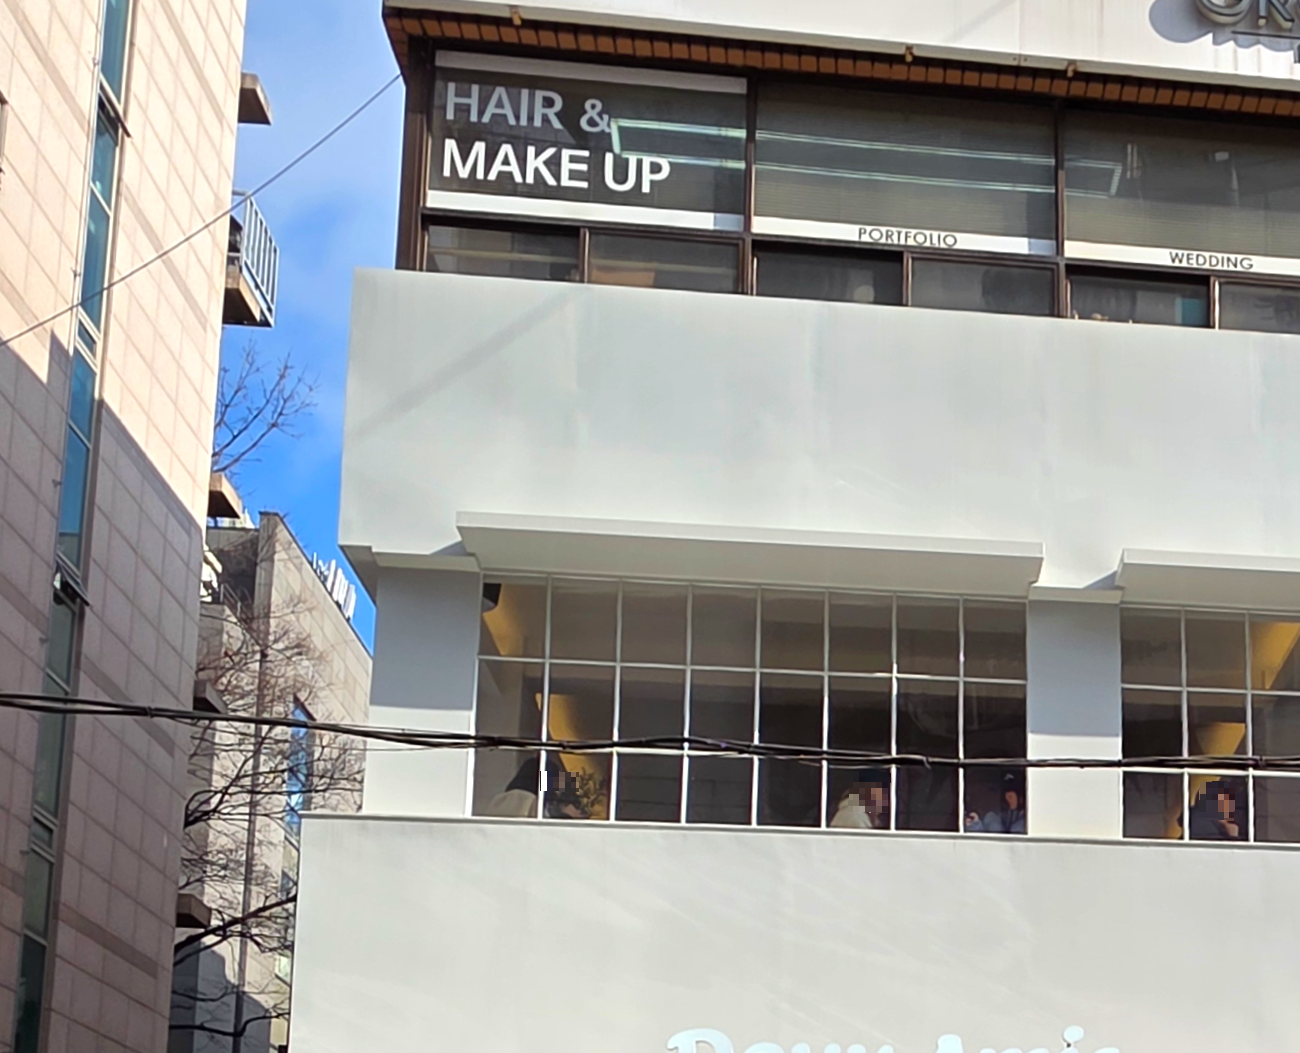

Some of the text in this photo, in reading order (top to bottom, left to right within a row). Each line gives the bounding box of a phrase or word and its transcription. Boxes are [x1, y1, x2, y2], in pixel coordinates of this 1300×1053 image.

[446, 82, 611, 132] HAIR &
[443, 138, 671, 194] MAKE UP
[857, 226, 958, 248] PORTFOLIO
[1169, 251, 1254, 271] WEDDING
